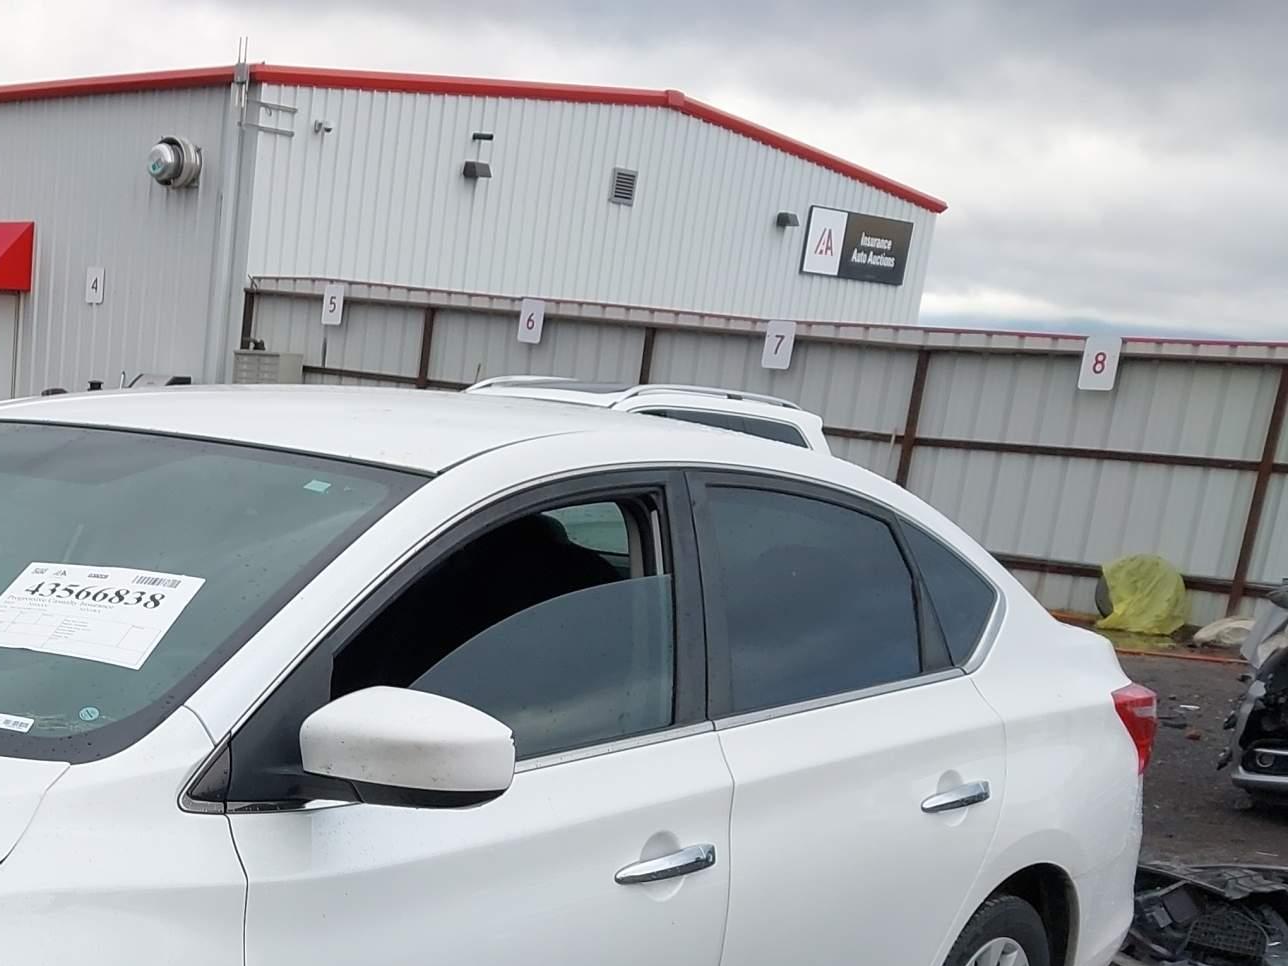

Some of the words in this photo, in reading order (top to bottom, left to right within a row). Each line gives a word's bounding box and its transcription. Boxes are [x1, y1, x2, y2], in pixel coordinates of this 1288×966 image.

[860, 231, 893, 251] Insurance
[851, 248, 868, 264] Auto
[867, 250, 896, 268] Auctions
[91, 276, 98, 294] 4
[328, 295, 337, 314] 5
[526, 312, 535, 331] 6
[774, 334, 785, 355] 7
[1092, 351, 1107, 375] 8
[24, 580, 166, 610] 43566838
